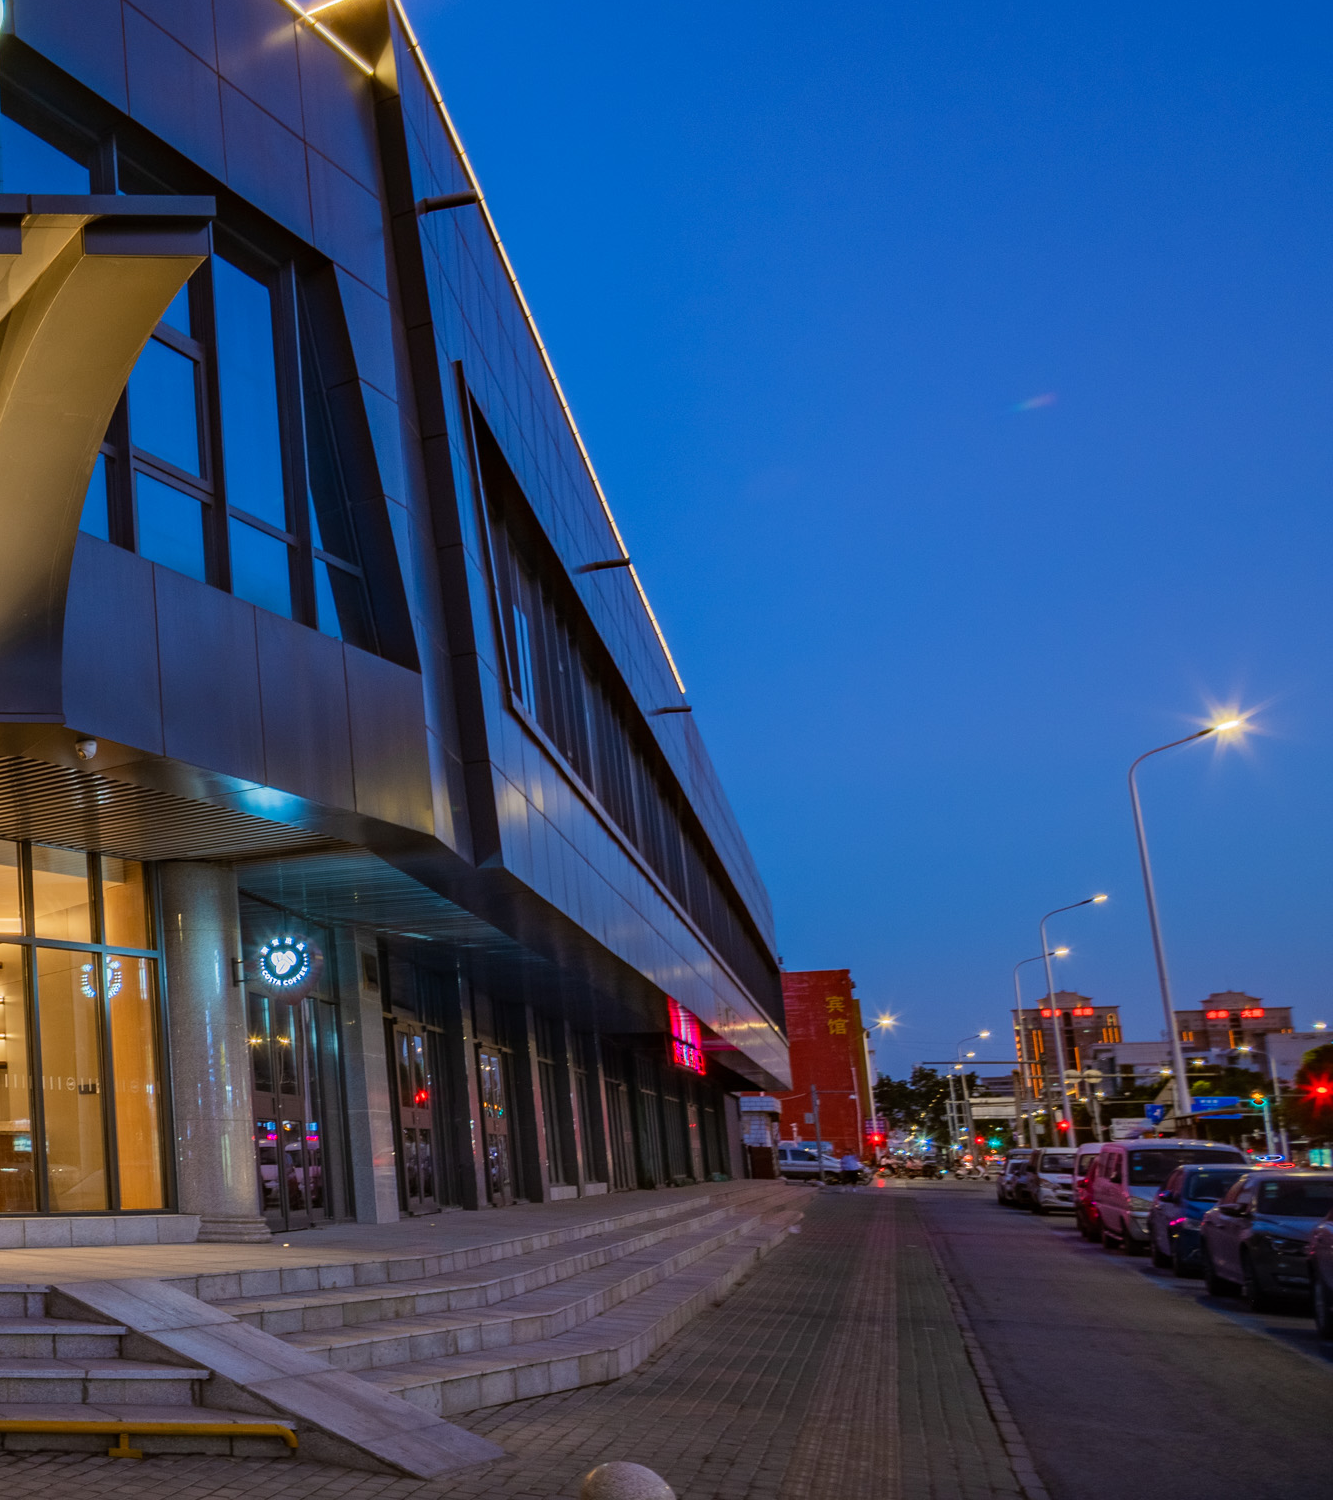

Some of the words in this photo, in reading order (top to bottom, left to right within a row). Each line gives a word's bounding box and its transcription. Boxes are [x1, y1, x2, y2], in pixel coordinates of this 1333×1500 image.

[261, 970, 282, 986] COSTA
[283, 965, 309, 986] COFFEE
[825, 996, 848, 1035] 宾馆
